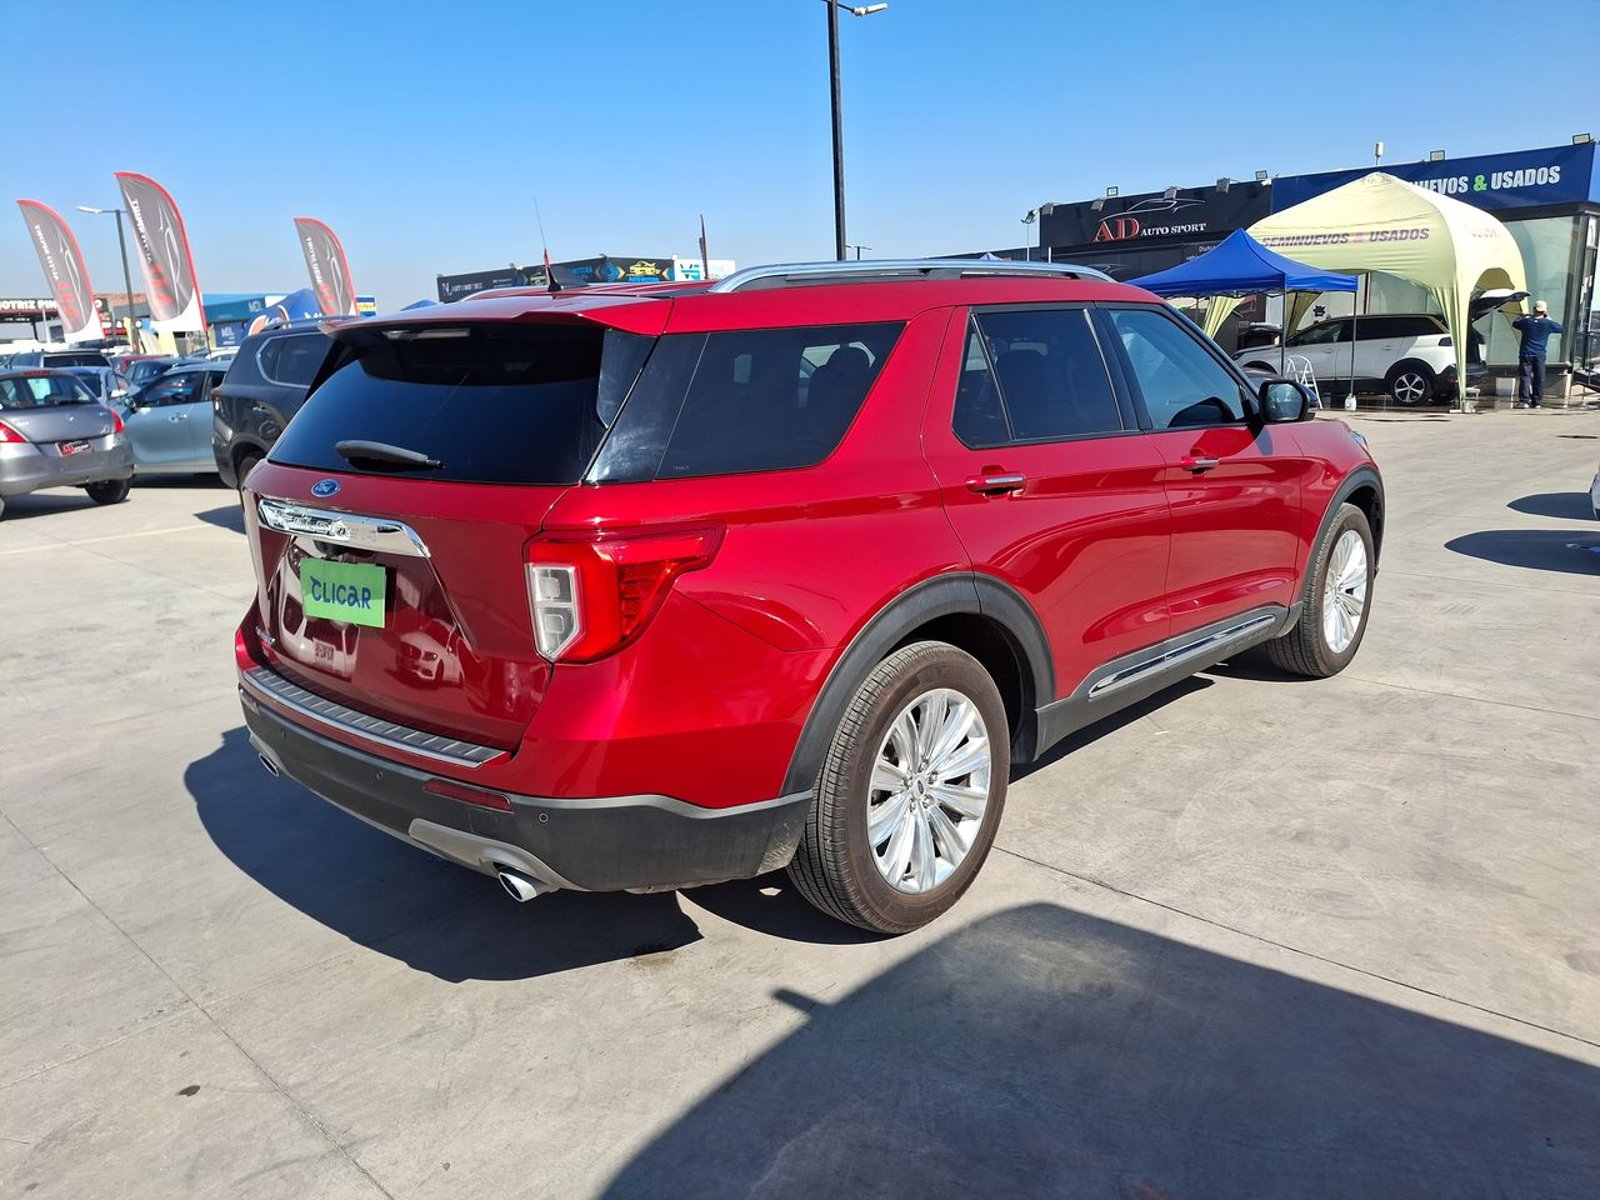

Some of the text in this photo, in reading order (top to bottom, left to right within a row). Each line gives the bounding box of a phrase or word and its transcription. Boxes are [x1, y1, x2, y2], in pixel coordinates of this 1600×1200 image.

[1473, 175, 1487, 192] &
[1491, 165, 1561, 190] USADOS
[1091, 217, 1207, 242] AD AUTO SPORT
[1263, 232, 1350, 247] SEMINUEVOS
[1369, 227, 1431, 243] USADOS
[0, 300, 36, 310] OTRIZ
